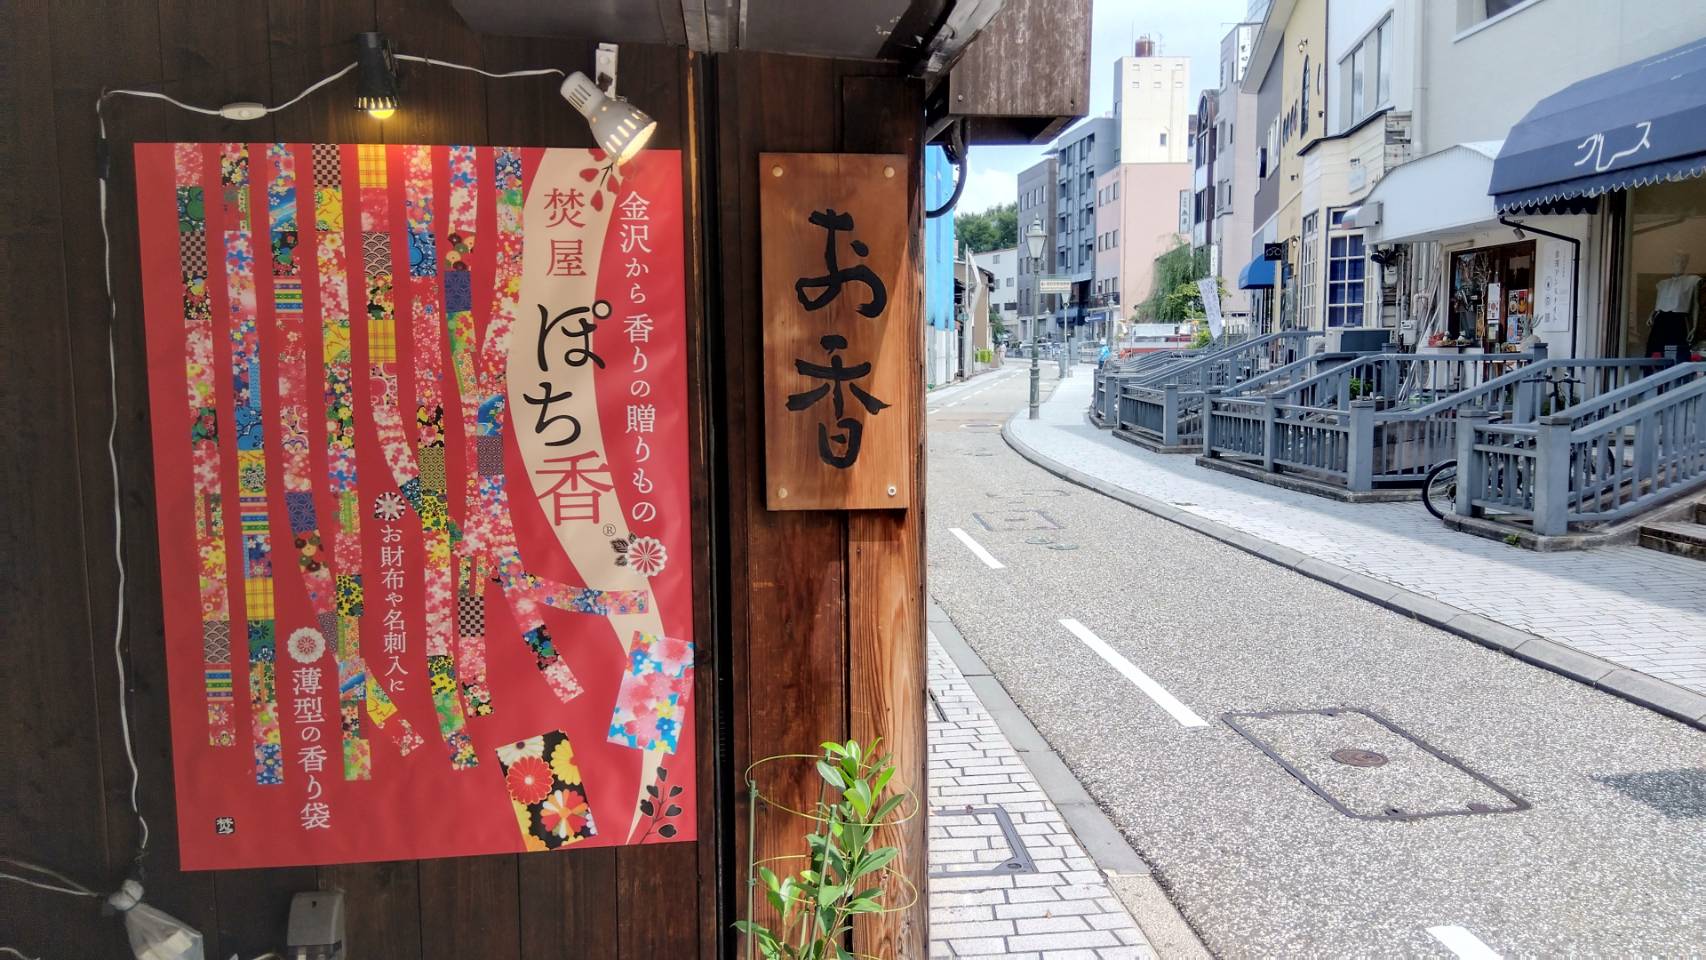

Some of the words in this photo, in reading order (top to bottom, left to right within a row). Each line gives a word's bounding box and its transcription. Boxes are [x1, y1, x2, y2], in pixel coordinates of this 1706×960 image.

[523, 299, 616, 527] ぽち香
[619, 190, 657, 522] 金沢から香りの贈りもの
[785, 208, 892, 469] お香
[380, 524, 409, 693] お財布や名刺入に
[292, 667, 331, 830] 薄型の香り袋
